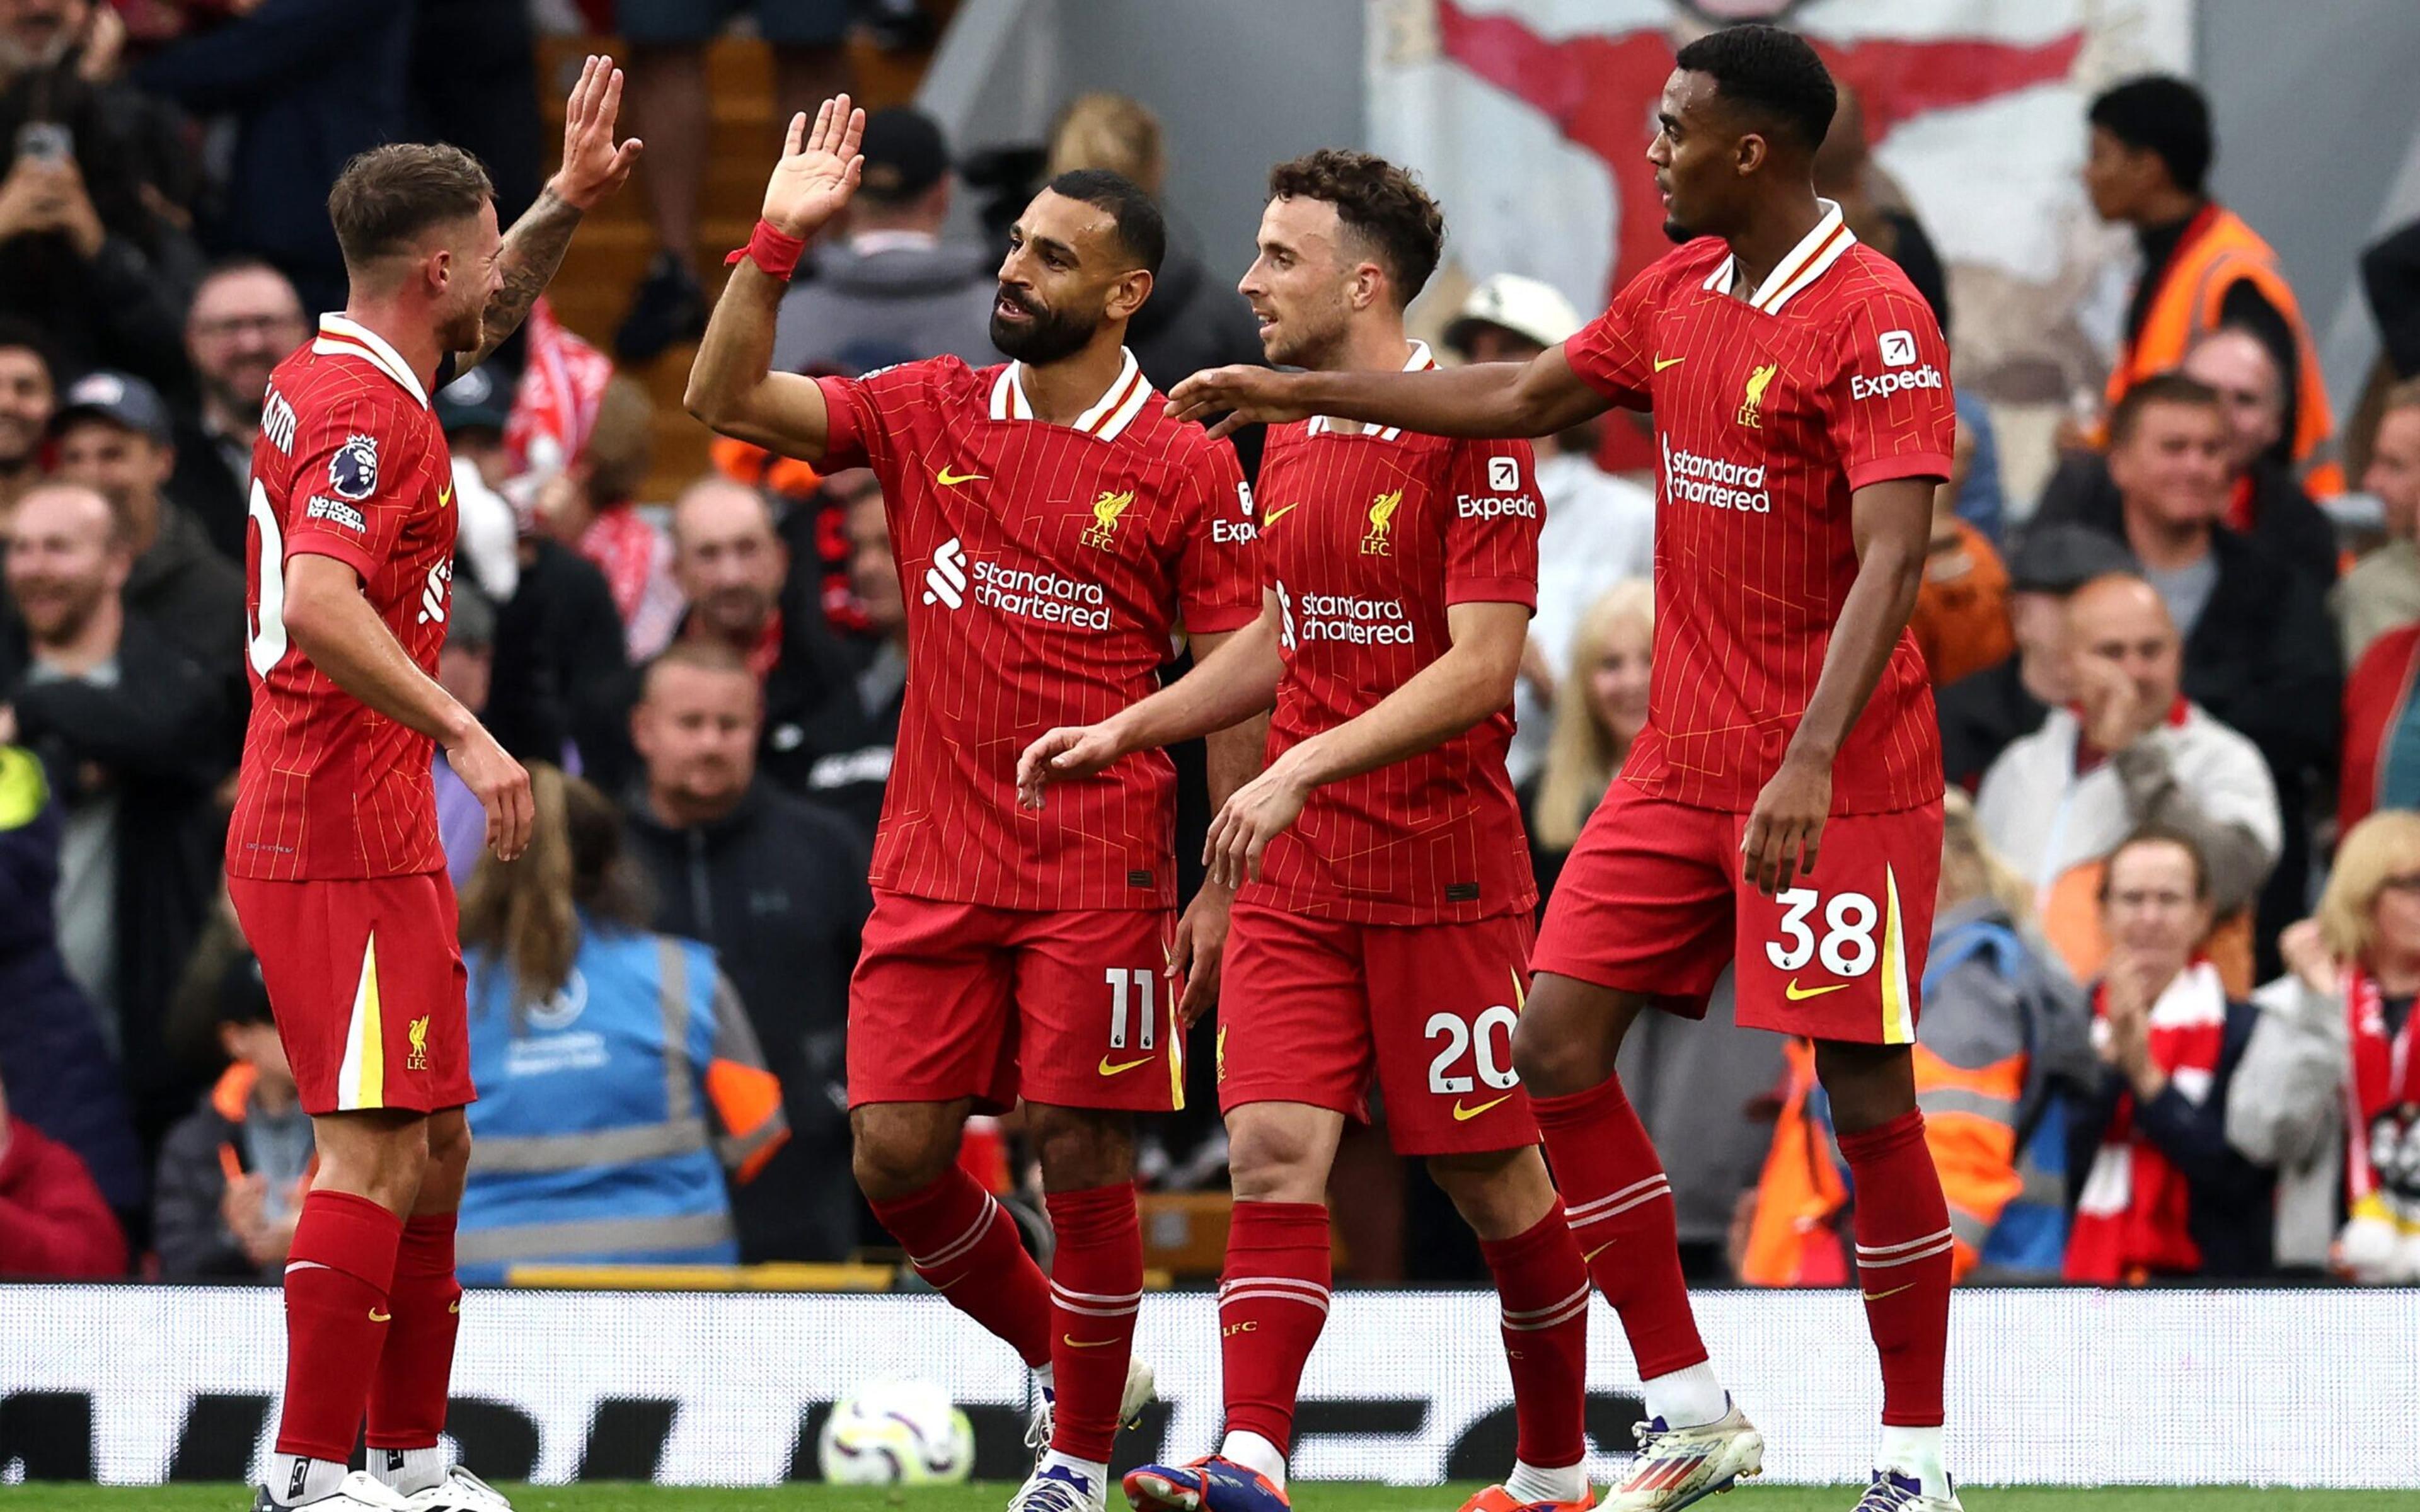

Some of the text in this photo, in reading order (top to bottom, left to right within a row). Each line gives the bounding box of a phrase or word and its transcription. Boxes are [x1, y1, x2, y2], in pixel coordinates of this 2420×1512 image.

[1851, 364, 1942, 401] Expedia
[1673, 449, 1765, 489] standard
[309, 495, 362, 524] No room
[1456, 493, 1536, 521] Expedia
[1673, 474, 1770, 513] chartered
[306, 505, 366, 534] for racism
[972, 561, 1103, 605] standard
[974, 583, 1110, 631] chartered
[1302, 616, 1414, 645] chartered
[1766, 887, 1878, 976] 38
[1106, 968, 1155, 1050] 11
[1424, 1005, 1521, 1094] 20
[1223, 1320, 1258, 1337] LFC
